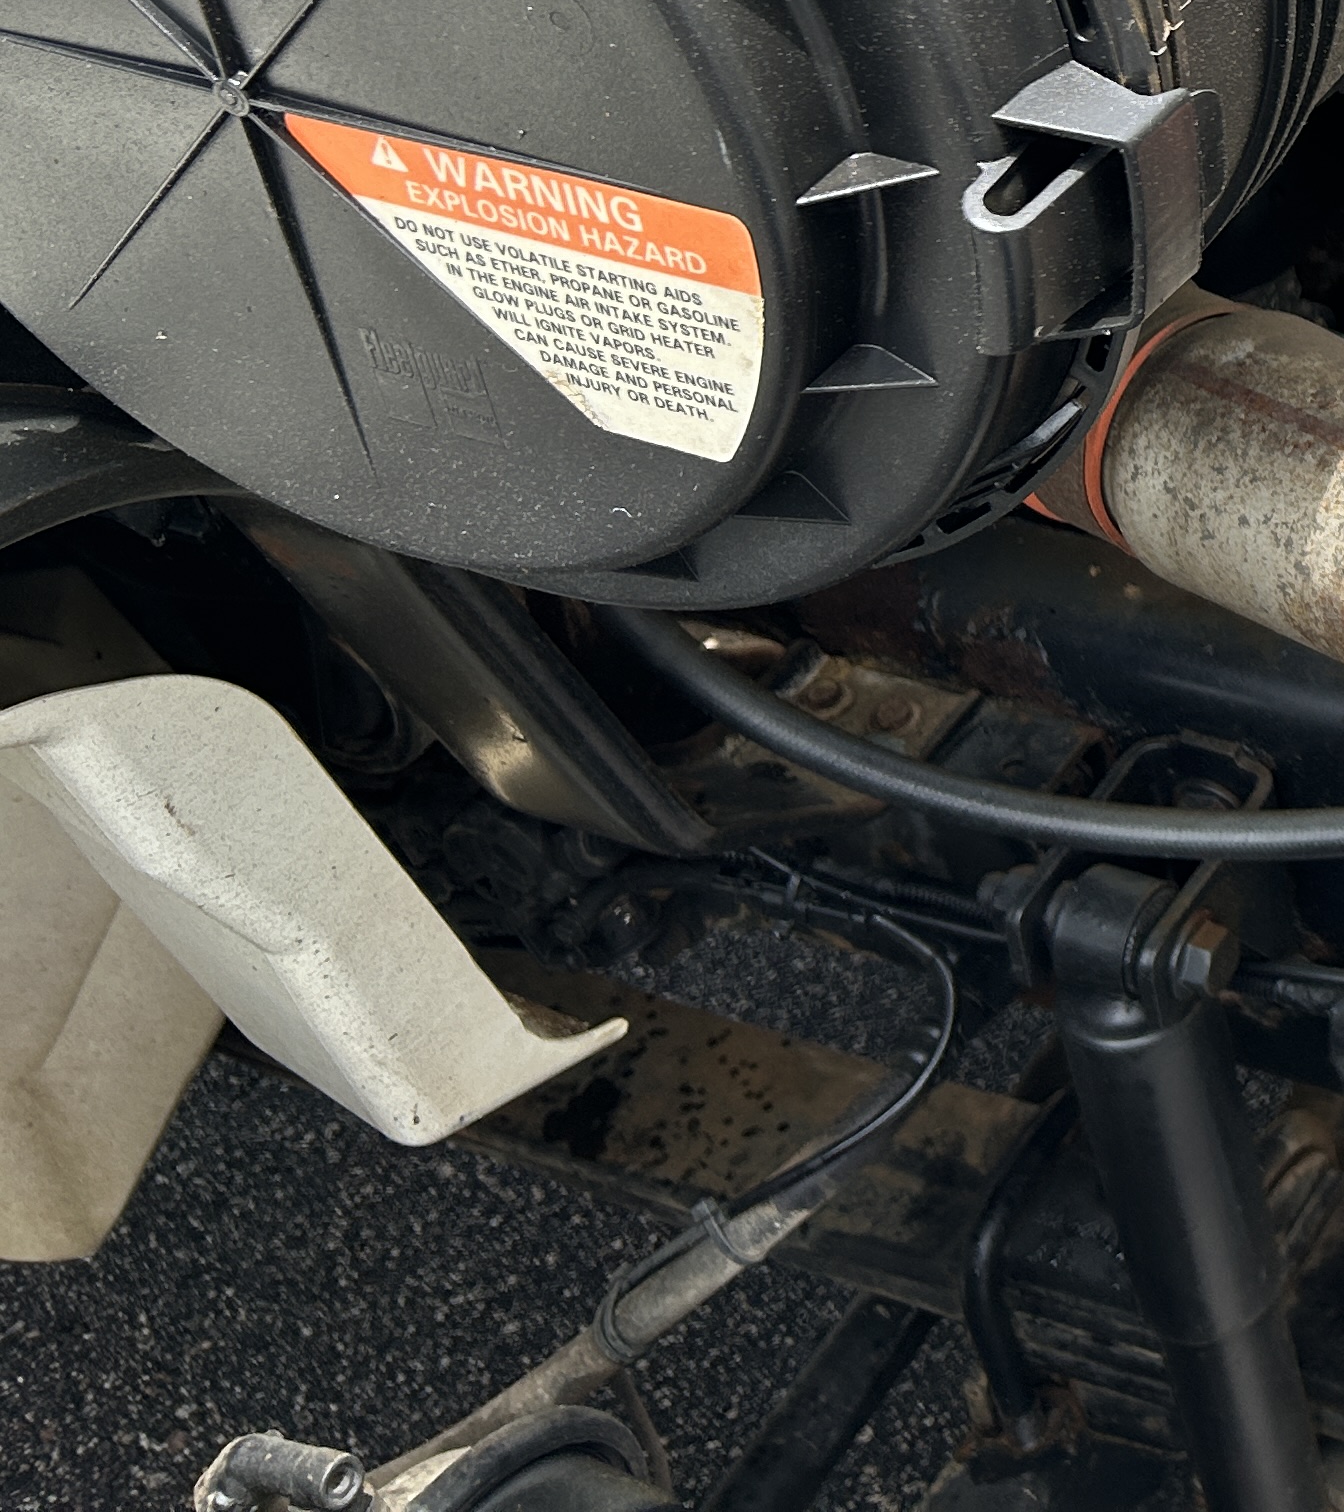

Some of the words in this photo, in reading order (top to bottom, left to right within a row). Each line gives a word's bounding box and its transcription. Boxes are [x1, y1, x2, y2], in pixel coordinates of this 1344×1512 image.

[405, 180, 571, 242] EXPLOSION
[578, 224, 707, 275] HAZARD
[422, 147, 643, 233] WARNING
[394, 216, 418, 233] DO
[422, 223, 455, 243] NOT
[459, 233, 492, 253] USE
[494, 241, 573, 274] VOLATILE
[576, 263, 658, 295] STARTING
[663, 286, 704, 306] AIDS
[415, 238, 460, 260] SUCH
[465, 251, 486, 267] AS
[550, 272, 624, 304] PROPANE
[629, 294, 653, 312] OR
[657, 301, 741, 332] GASOLINE
[446, 262, 463, 277] IN
[466, 267, 499, 287] THE
[502, 277, 560, 303] ENGINE
[565, 293, 591, 311] AIR
[594, 301, 654, 328] INTAKE
[658, 318, 732, 347] SYSTEM.
[472, 285, 520, 308] GLOW
[524, 298, 576, 323] PLUGS
[581, 314, 604, 331] OR
[607, 321, 646, 341] GRID
[650, 332, 716, 359] HEATER
[492, 306, 532, 327] WILL
[534, 317, 586, 341] IGNITE
[589, 332, 662, 362] VAPORS.
[514, 328, 549, 347] CAN
[553, 338, 607, 363] CAUSE
[610, 353, 671, 380] SEVERE
[674, 370, 735, 396] ENGINE
[539, 350, 610, 379] DAMAGE
[615, 370, 648, 389] AND
[652, 380, 739, 413] PERSONAL
[565, 372, 621, 399] INJURY
[627, 389, 650, 406] OR
[653, 396, 715, 422] DEATH.
